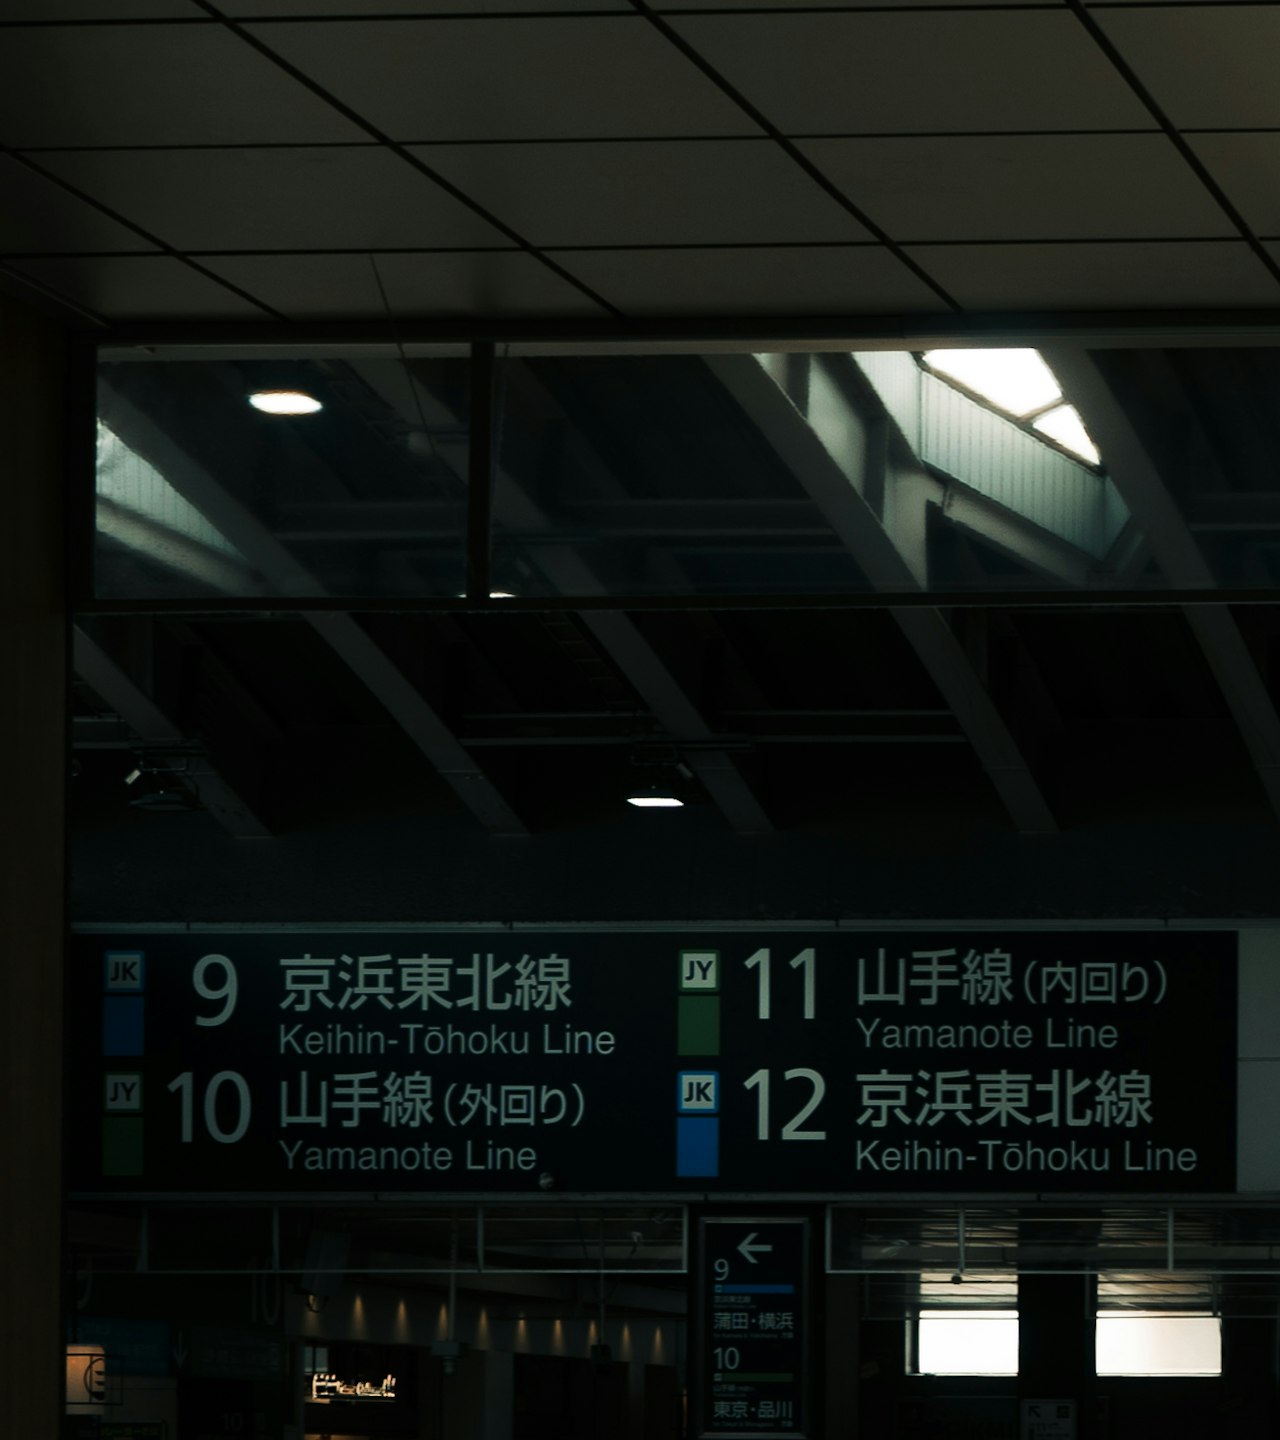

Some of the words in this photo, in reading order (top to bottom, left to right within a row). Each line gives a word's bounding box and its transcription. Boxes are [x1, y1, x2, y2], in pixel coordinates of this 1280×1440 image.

[110, 962, 138, 982] JK
[278, 954, 573, 1013] 京浜東北線
[684, 960, 713, 981] JY
[743, 947, 818, 1021] 11
[191, 954, 239, 1028] 9
[279, 1024, 531, 1056] Keihin-Tōhoku
[542, 1024, 616, 1056] Line
[855, 1018, 1033, 1048] Yamanote
[1045, 1018, 1118, 1048] Line
[110, 1082, 137, 1103] JY
[684, 1081, 712, 1103] JK
[742, 1067, 828, 1141] 12
[855, 1069, 1153, 1129] 京浜東北線
[166, 1070, 254, 1145] 10
[279, 1140, 453, 1171] Yamanote
[466, 1140, 537, 1171] Line
[855, 1141, 1112, 1172] Keihin-Tōhoku
[1123, 1141, 1198, 1172] Line
[714, 1258, 730, 1281] 9
[713, 1312, 795, 1330] 蒲田・横浜
[713, 1346, 740, 1370] 10
[713, 1400, 794, 1419] 東京・品川
